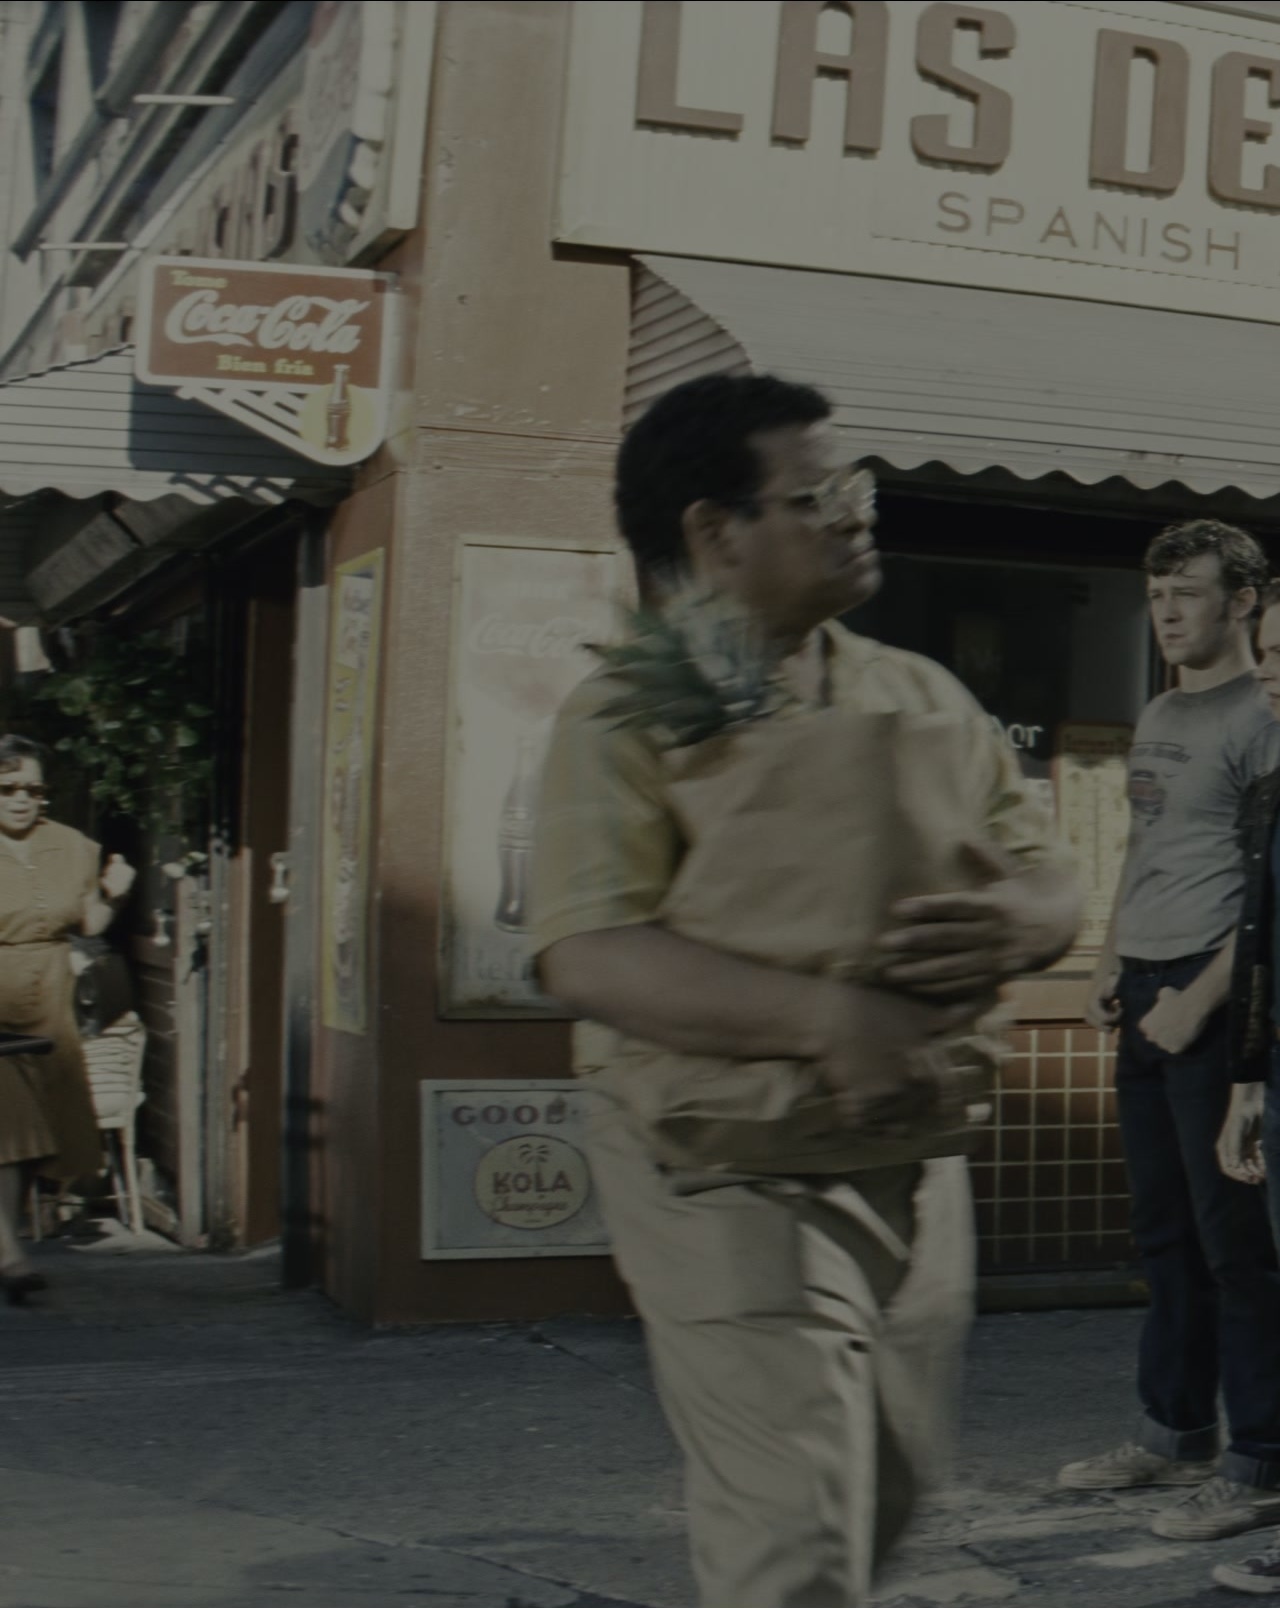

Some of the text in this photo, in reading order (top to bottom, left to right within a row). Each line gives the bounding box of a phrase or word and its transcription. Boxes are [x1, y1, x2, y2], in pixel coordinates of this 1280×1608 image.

[635, 2, 1017, 173] LAS
[936, 191, 1241, 270] SPANISH
[165, 289, 371, 353] Coca-Cola
[217, 354, 266, 373] Bien
[492, 1171, 573, 1194] KOLA
